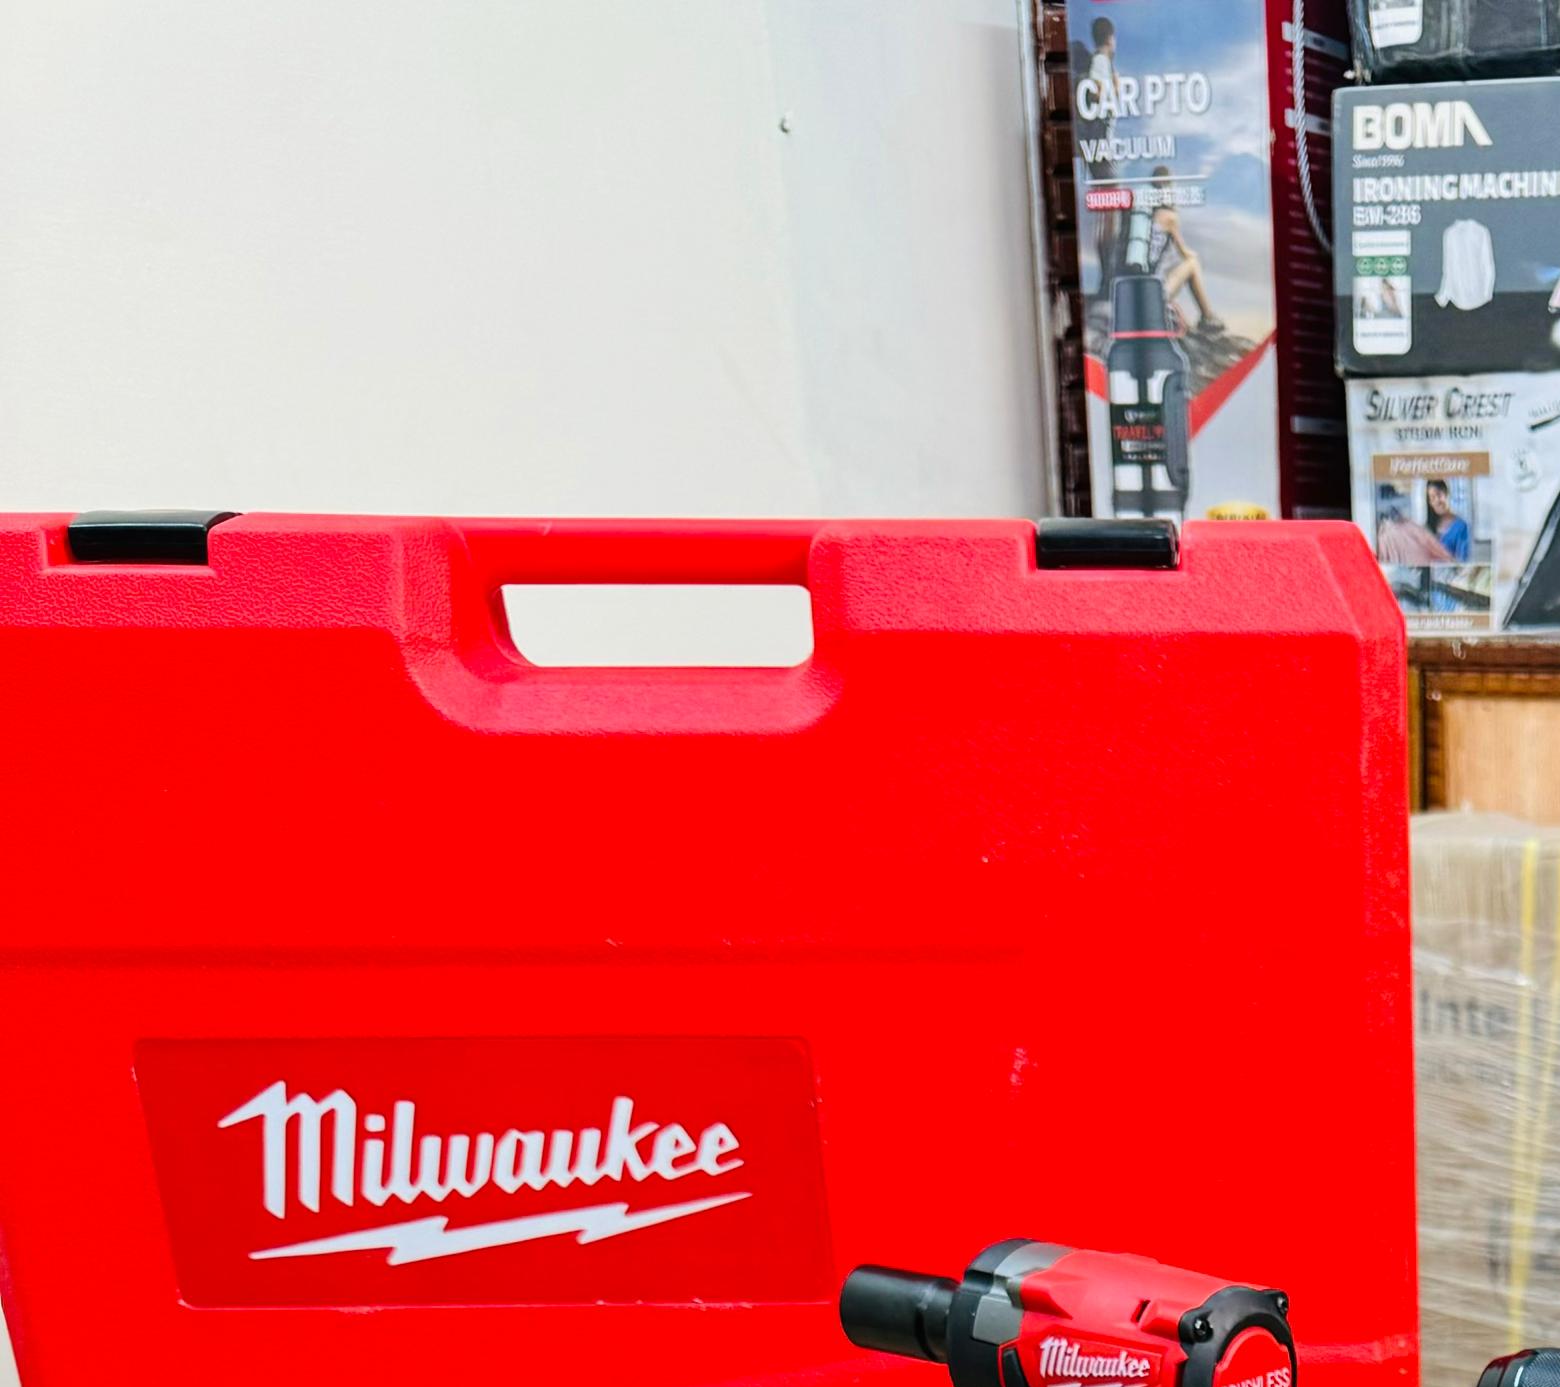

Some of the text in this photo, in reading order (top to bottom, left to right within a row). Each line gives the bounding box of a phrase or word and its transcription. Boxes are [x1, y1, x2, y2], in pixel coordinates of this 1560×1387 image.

[1077, 72, 1211, 120] CAR PTO
[1079, 136, 1175, 163] VACUUM
[1353, 173, 1458, 203] IRONING
[1365, 389, 1438, 422] SILVER
[1446, 387, 1515, 419] CREST
[218, 1080, 745, 1219] Milwaukee
[1039, 1335, 1150, 1378] Milwaukee
